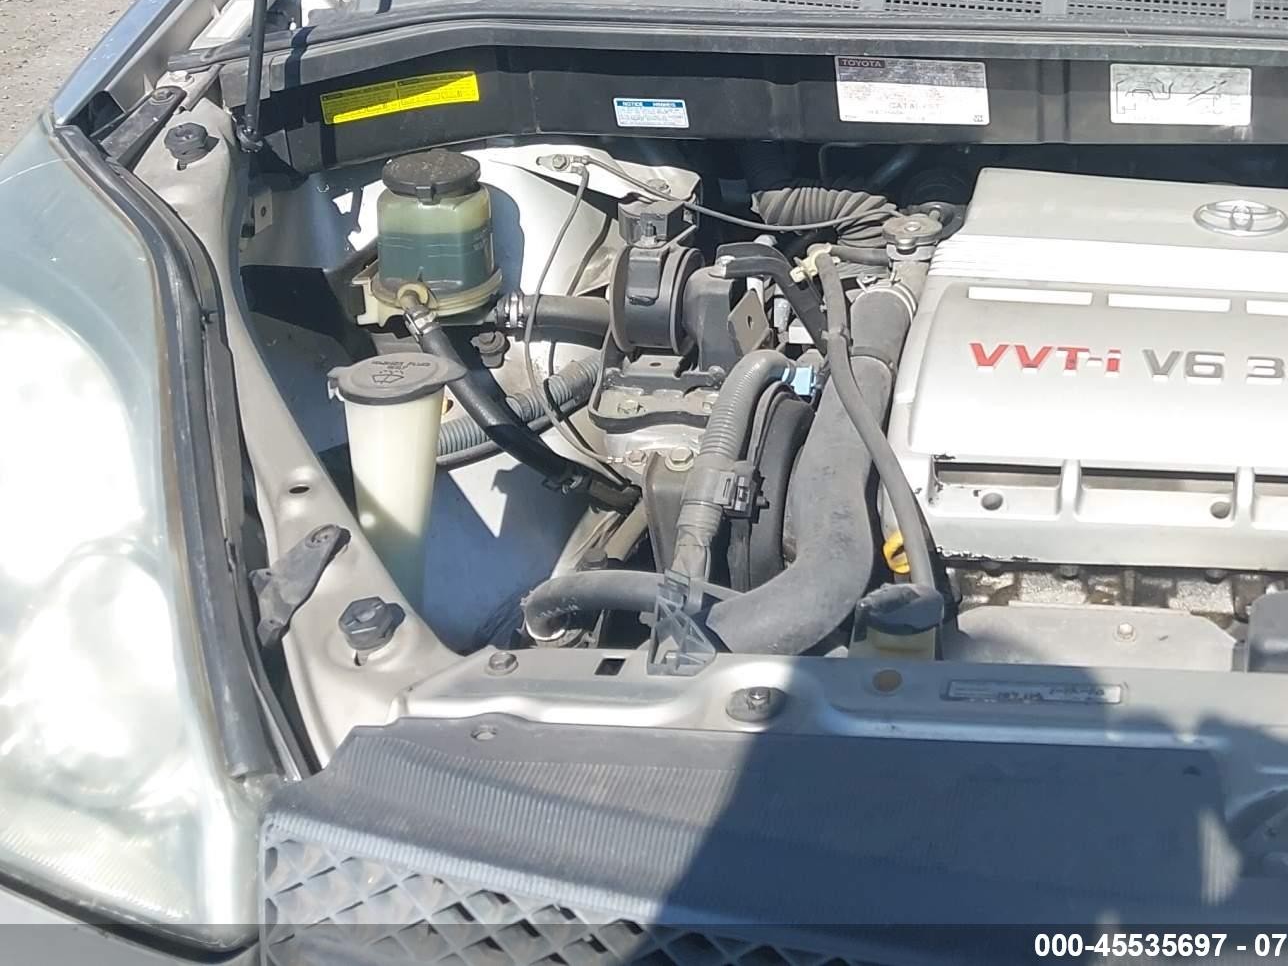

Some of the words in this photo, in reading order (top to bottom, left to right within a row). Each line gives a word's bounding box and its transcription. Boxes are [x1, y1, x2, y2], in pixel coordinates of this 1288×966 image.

[840, 59, 883, 68] TOYOTA
[968, 342, 1124, 375] VVT-i
[1142, 348, 1227, 386] V6
